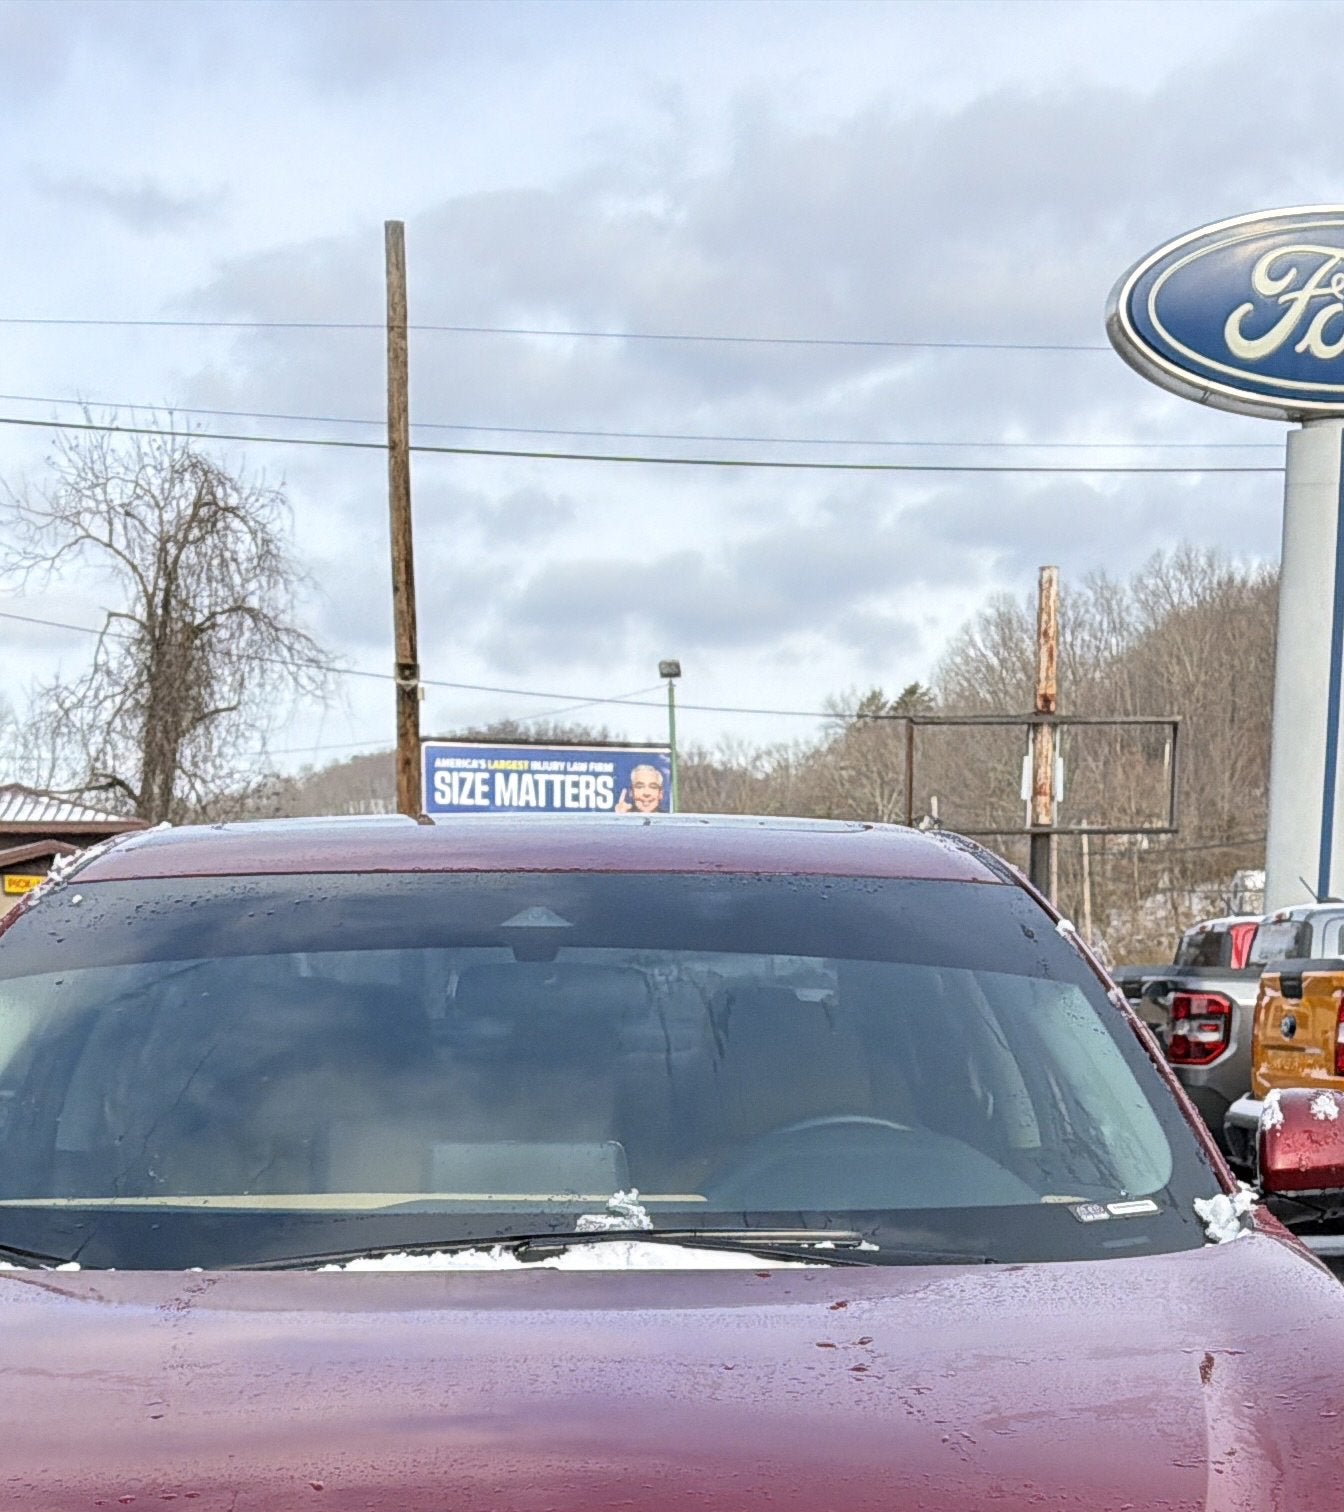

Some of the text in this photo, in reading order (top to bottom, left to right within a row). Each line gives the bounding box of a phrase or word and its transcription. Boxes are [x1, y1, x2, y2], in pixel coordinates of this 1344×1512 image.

[434, 757, 614, 773] AMERICA'S LARGEST INJURY LAW FIRM
[434, 770, 614, 809] SIZE MATTERS
